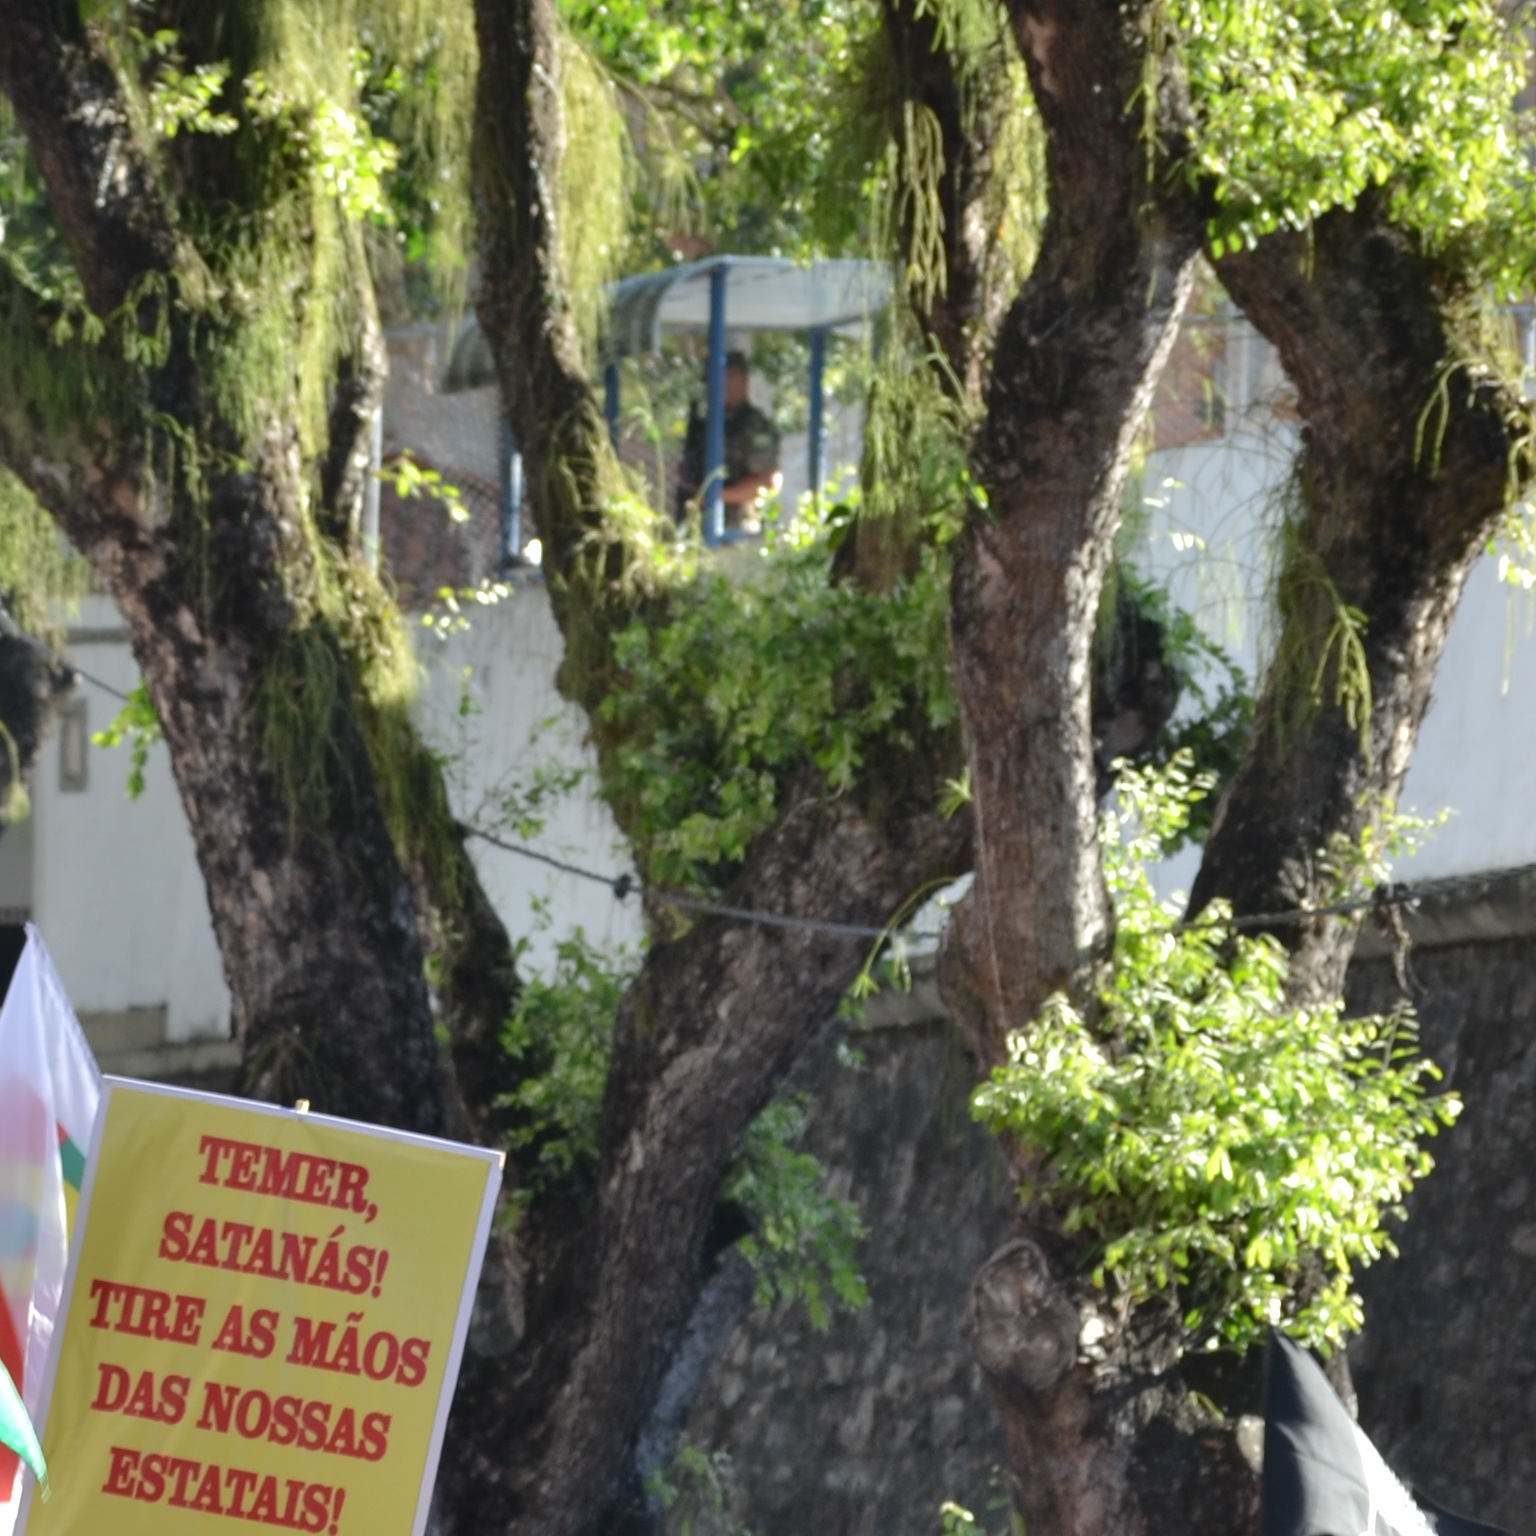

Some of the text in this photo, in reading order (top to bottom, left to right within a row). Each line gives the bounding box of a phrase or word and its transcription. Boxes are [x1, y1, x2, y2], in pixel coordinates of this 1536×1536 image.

[198, 1134, 379, 1223] TEMER,
[158, 1210, 390, 1299] SATANÁS!
[89, 1278, 432, 1387] TIRE AS MÃOS
[90, 1362, 393, 1463] DAS NOSSAS
[102, 1446, 346, 1536] ESTATAIS!
